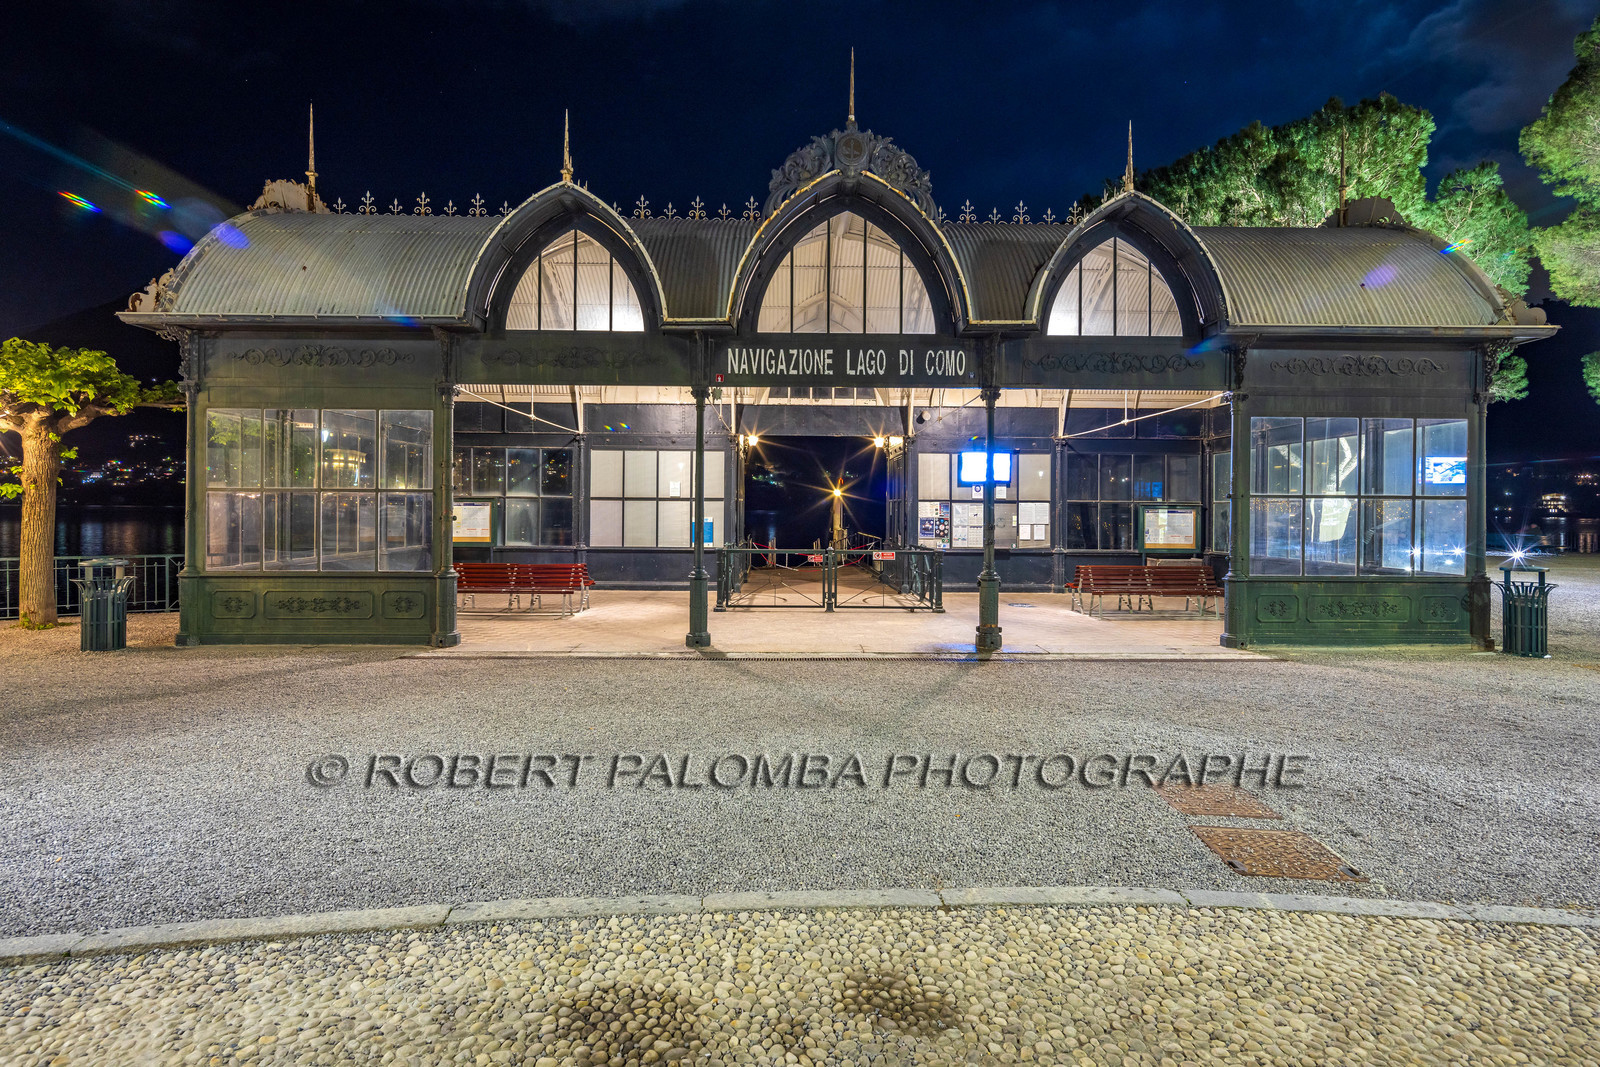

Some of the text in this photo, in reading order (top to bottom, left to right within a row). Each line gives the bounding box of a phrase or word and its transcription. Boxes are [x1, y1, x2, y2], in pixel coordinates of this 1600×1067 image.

[727, 348, 966, 376] NAVIGAZIONE LAGO DI COMO
